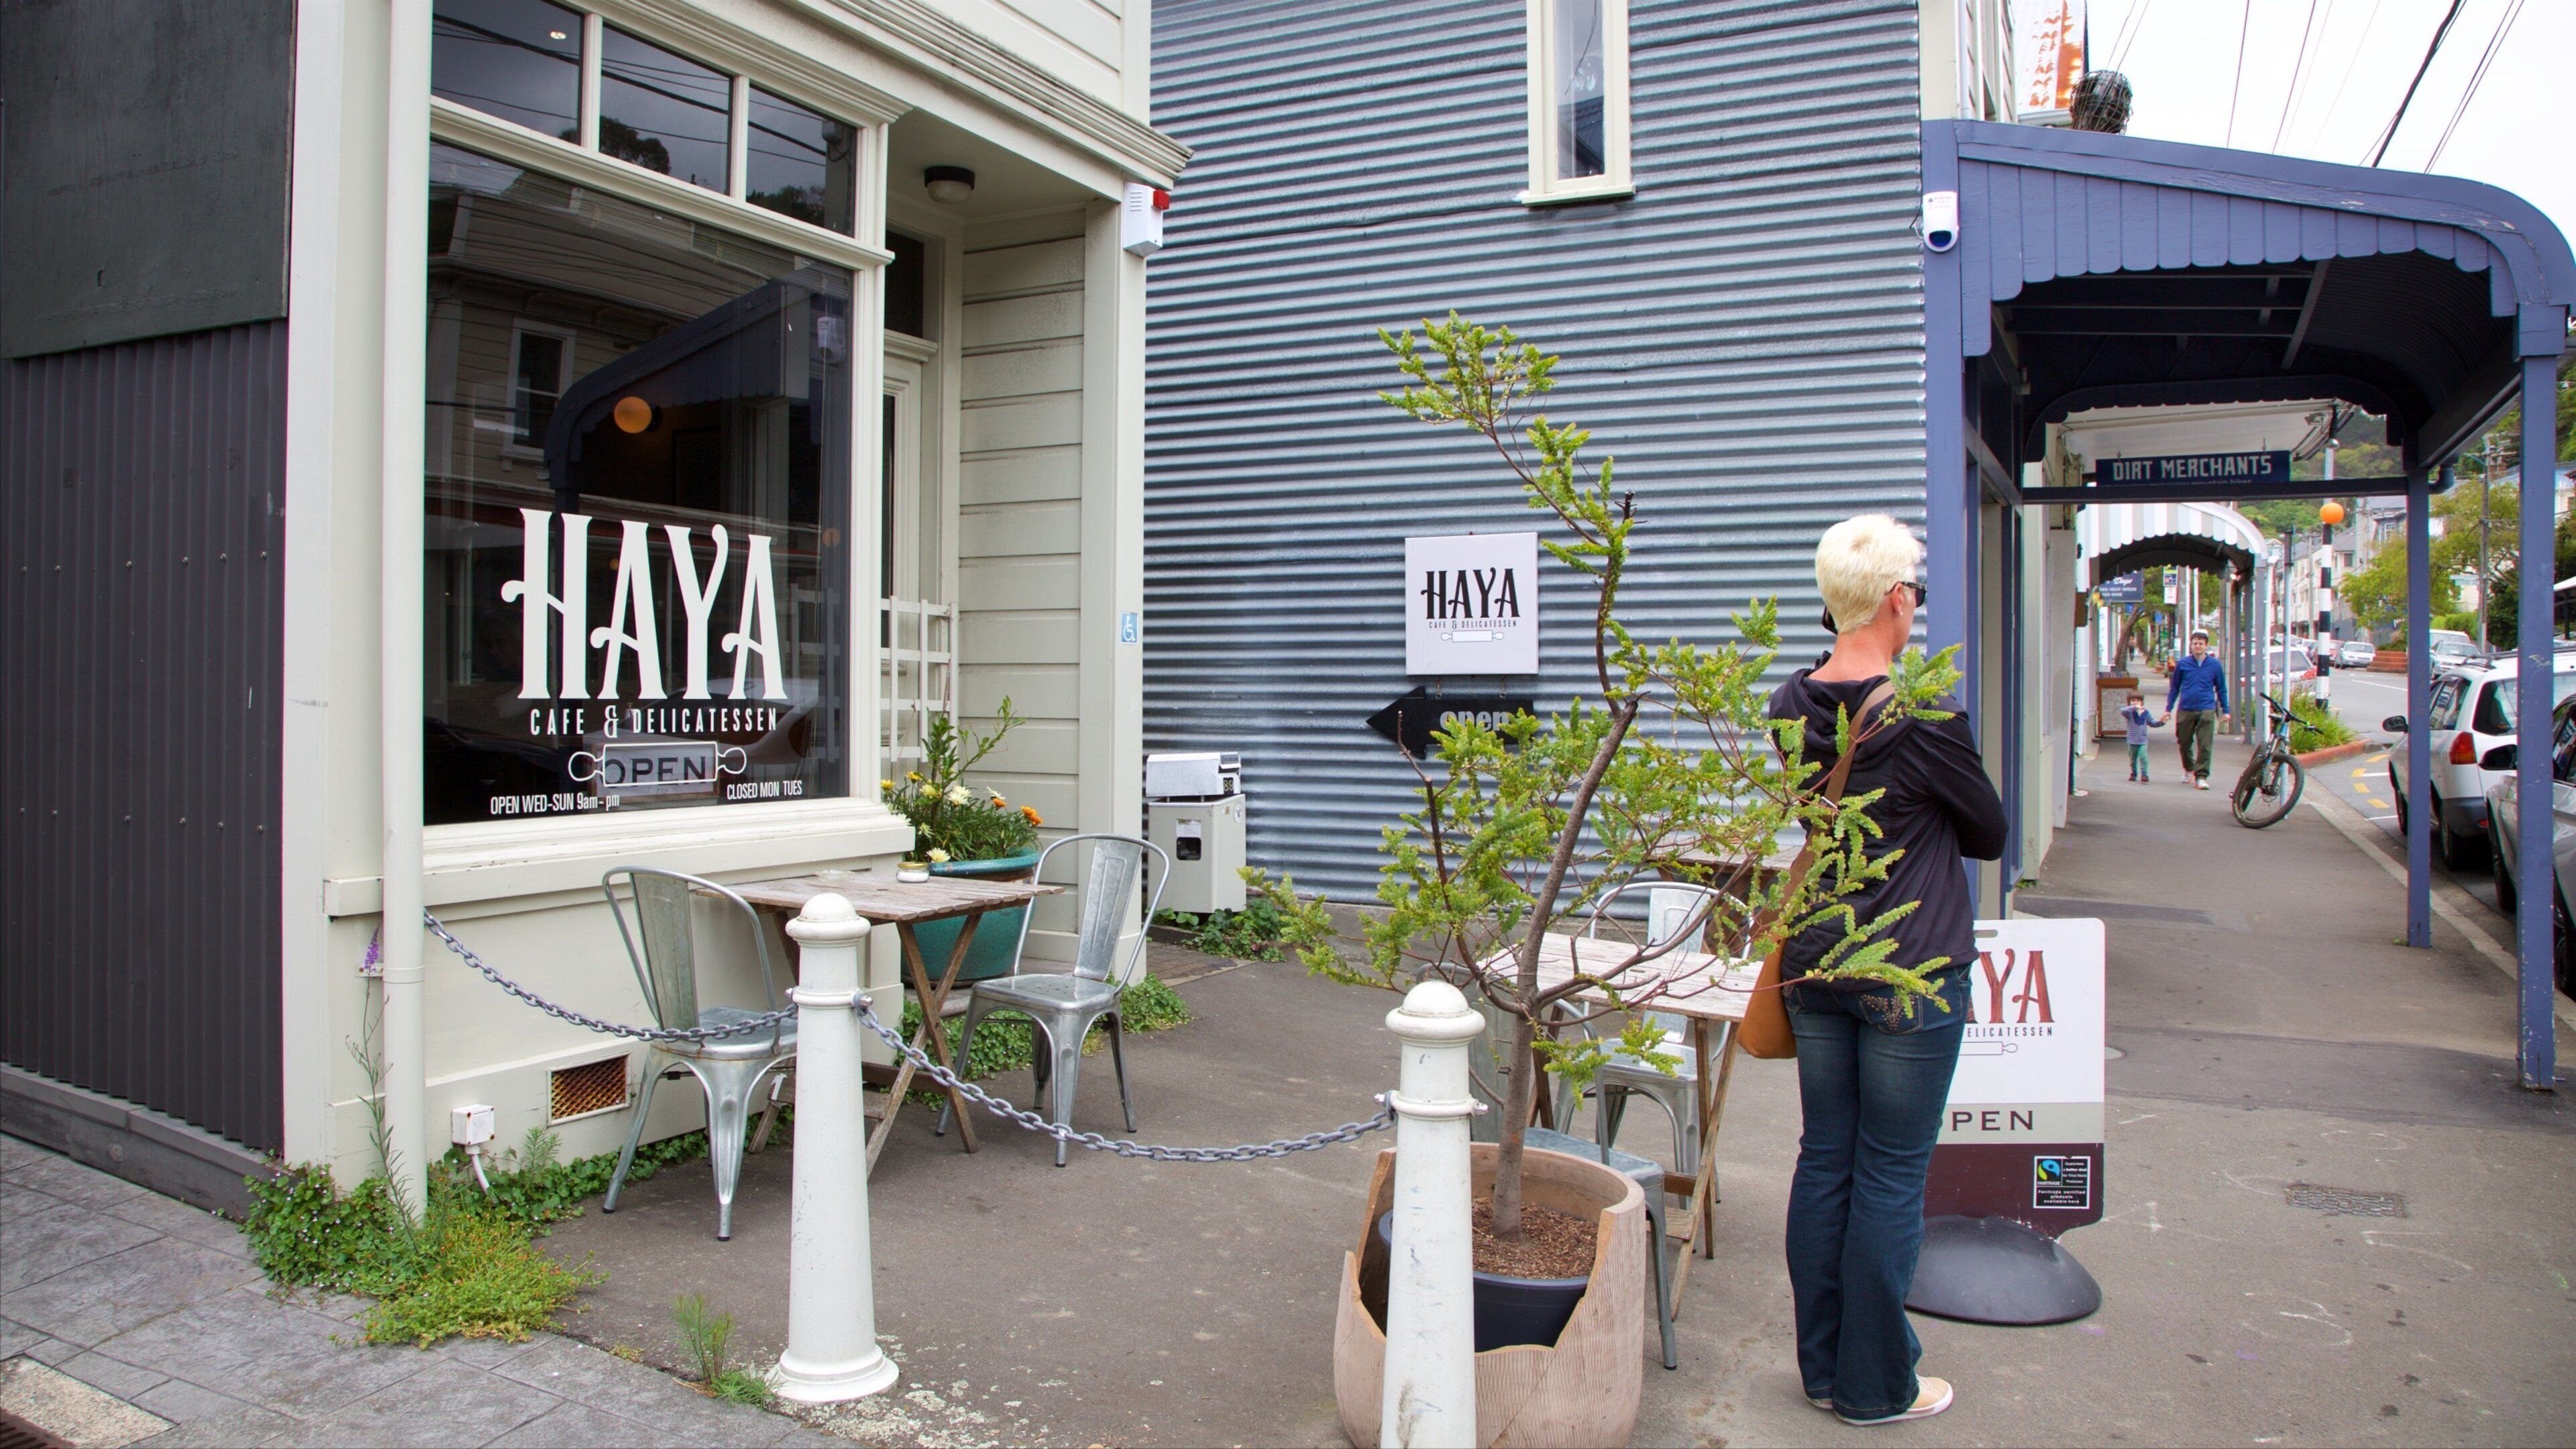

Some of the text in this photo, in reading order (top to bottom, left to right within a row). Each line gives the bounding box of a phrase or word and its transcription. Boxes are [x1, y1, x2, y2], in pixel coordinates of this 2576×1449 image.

[2113, 455, 2272, 481] DIRT MERCHANTS
[500, 508, 788, 700] HAYA
[1421, 567, 1520, 619] HAYA
[1452, 619, 1457, 629] &
[1461, 620, 1517, 628] DELICATESSEN
[530, 705, 777, 738] CAFE & DELICATESSEN
[600, 756, 706, 788] OPEN
[727, 780, 802, 800] CLOSED MON TUES
[490, 795, 519, 814] OPEN
[522, 793, 574, 813] WED-SUN
[1966, 949, 2055, 1024] YA
[1967, 1026, 2052, 1037] ELICATESSEN
[1951, 1110, 2033, 1131] PEN
